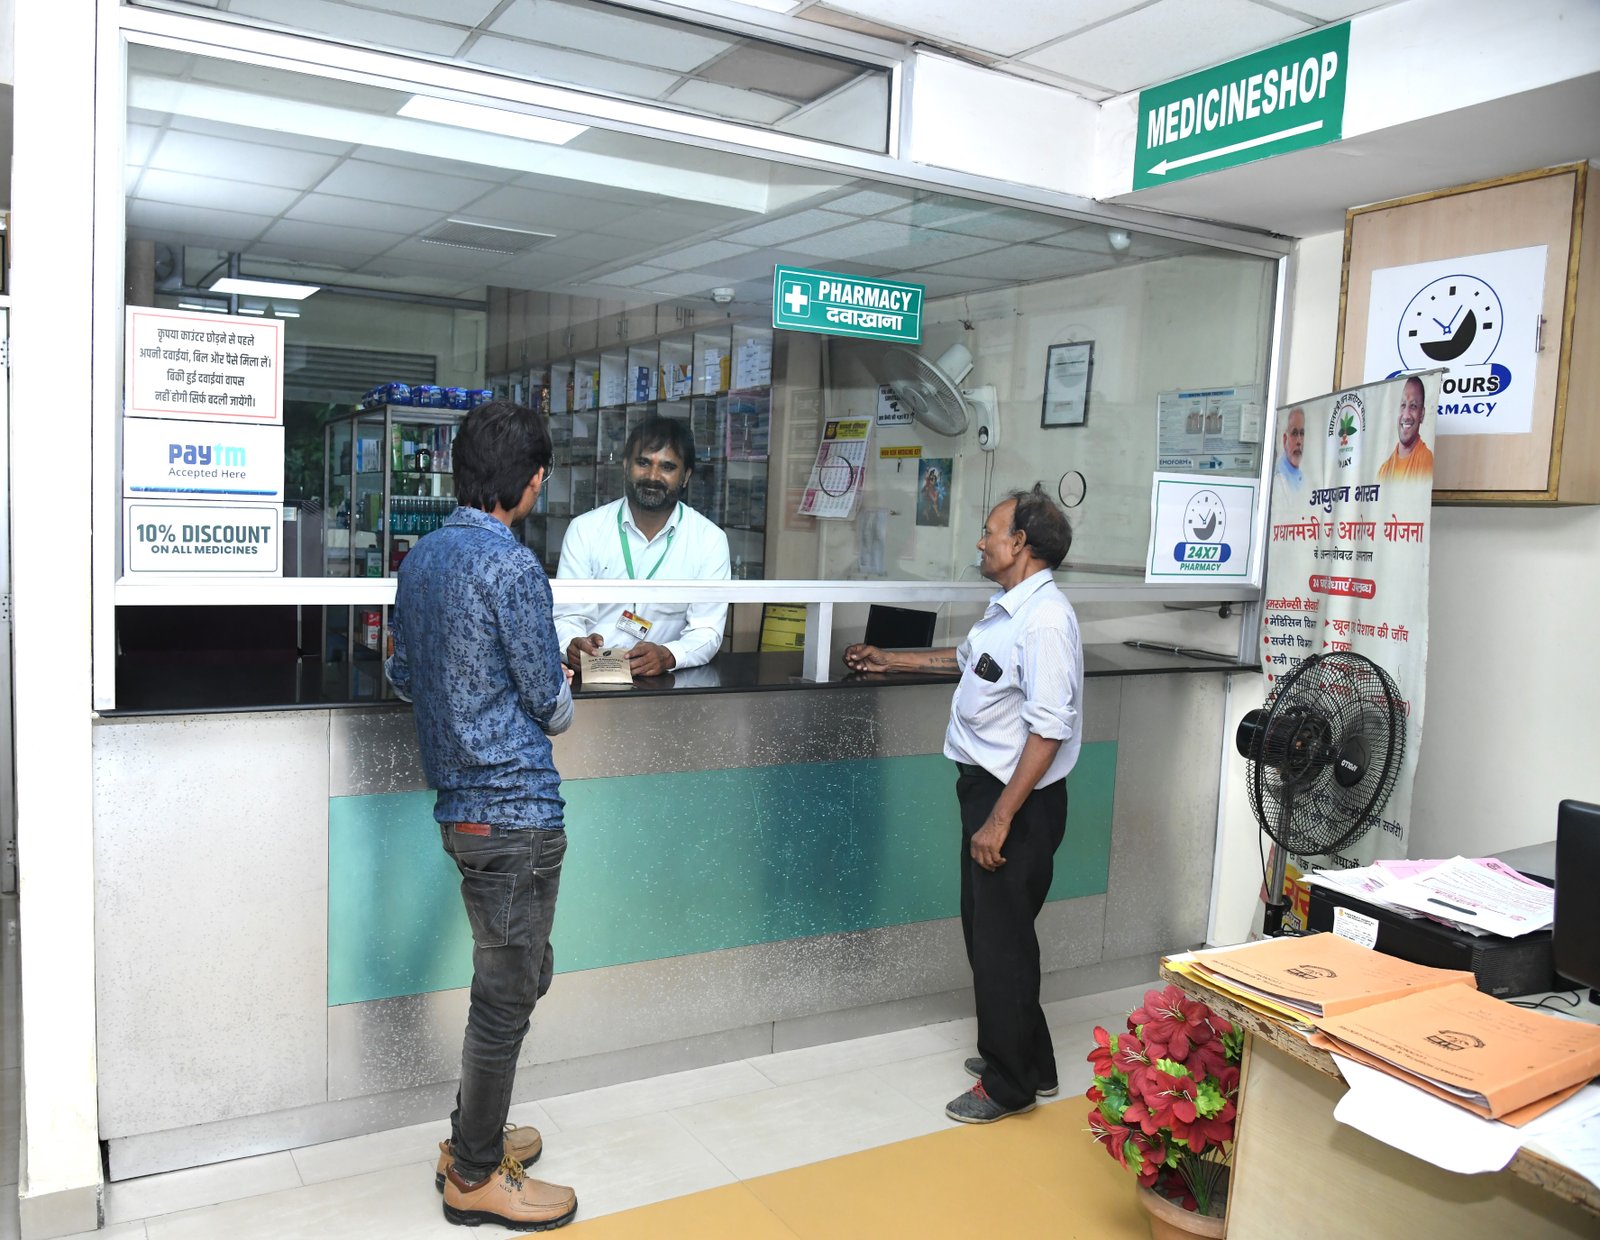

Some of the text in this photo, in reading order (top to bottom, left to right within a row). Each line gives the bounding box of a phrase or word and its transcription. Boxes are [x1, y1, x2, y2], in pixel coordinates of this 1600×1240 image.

[1147, 50, 1338, 150] MEDICINESHOP
[819, 280, 912, 311] PHARMACY
[826, 306, 903, 331] दवाखाना
[158, 328, 254, 346] कृपया काउंटर छोड़ने से पहले
[140, 346, 160, 359] अपनी
[193, 349, 208, 363] बिल
[211, 351, 224, 364] और
[226, 352, 238, 366] पैसे
[240, 353, 258, 367] मिला
[167, 368, 184, 381] बिकी
[186, 370, 196, 385] हुई
[225, 375, 245, 386] वापस
[1442, 376, 1499, 394] OURS
[155, 389, 171, 402] नहीं
[172, 390, 187, 403] होगी
[189, 390, 206, 404] सिर्फ
[208, 392, 227, 405] बदली
[1437, 402, 1497, 417] RMACY
[168, 467, 246, 480] Accepted Here
[1355, 484, 1380, 502] भारत
[137, 524, 271, 544] 10% DISCOUNT
[1273, 516, 1320, 541] प्रधानमंत्री
[1384, 514, 1424, 543] योजना
[151, 544, 258, 555] ON ALL MEDICINES
[1187, 546, 1219, 559] 24X7
[1180, 562, 1221, 571] PHARMACY
[1270, 615, 1302, 628] मेडिसिन
[1378, 622, 1388, 639] की
[1270, 634, 1295, 646] सर्जरी
[1272, 653, 1287, 665] स्त्री
